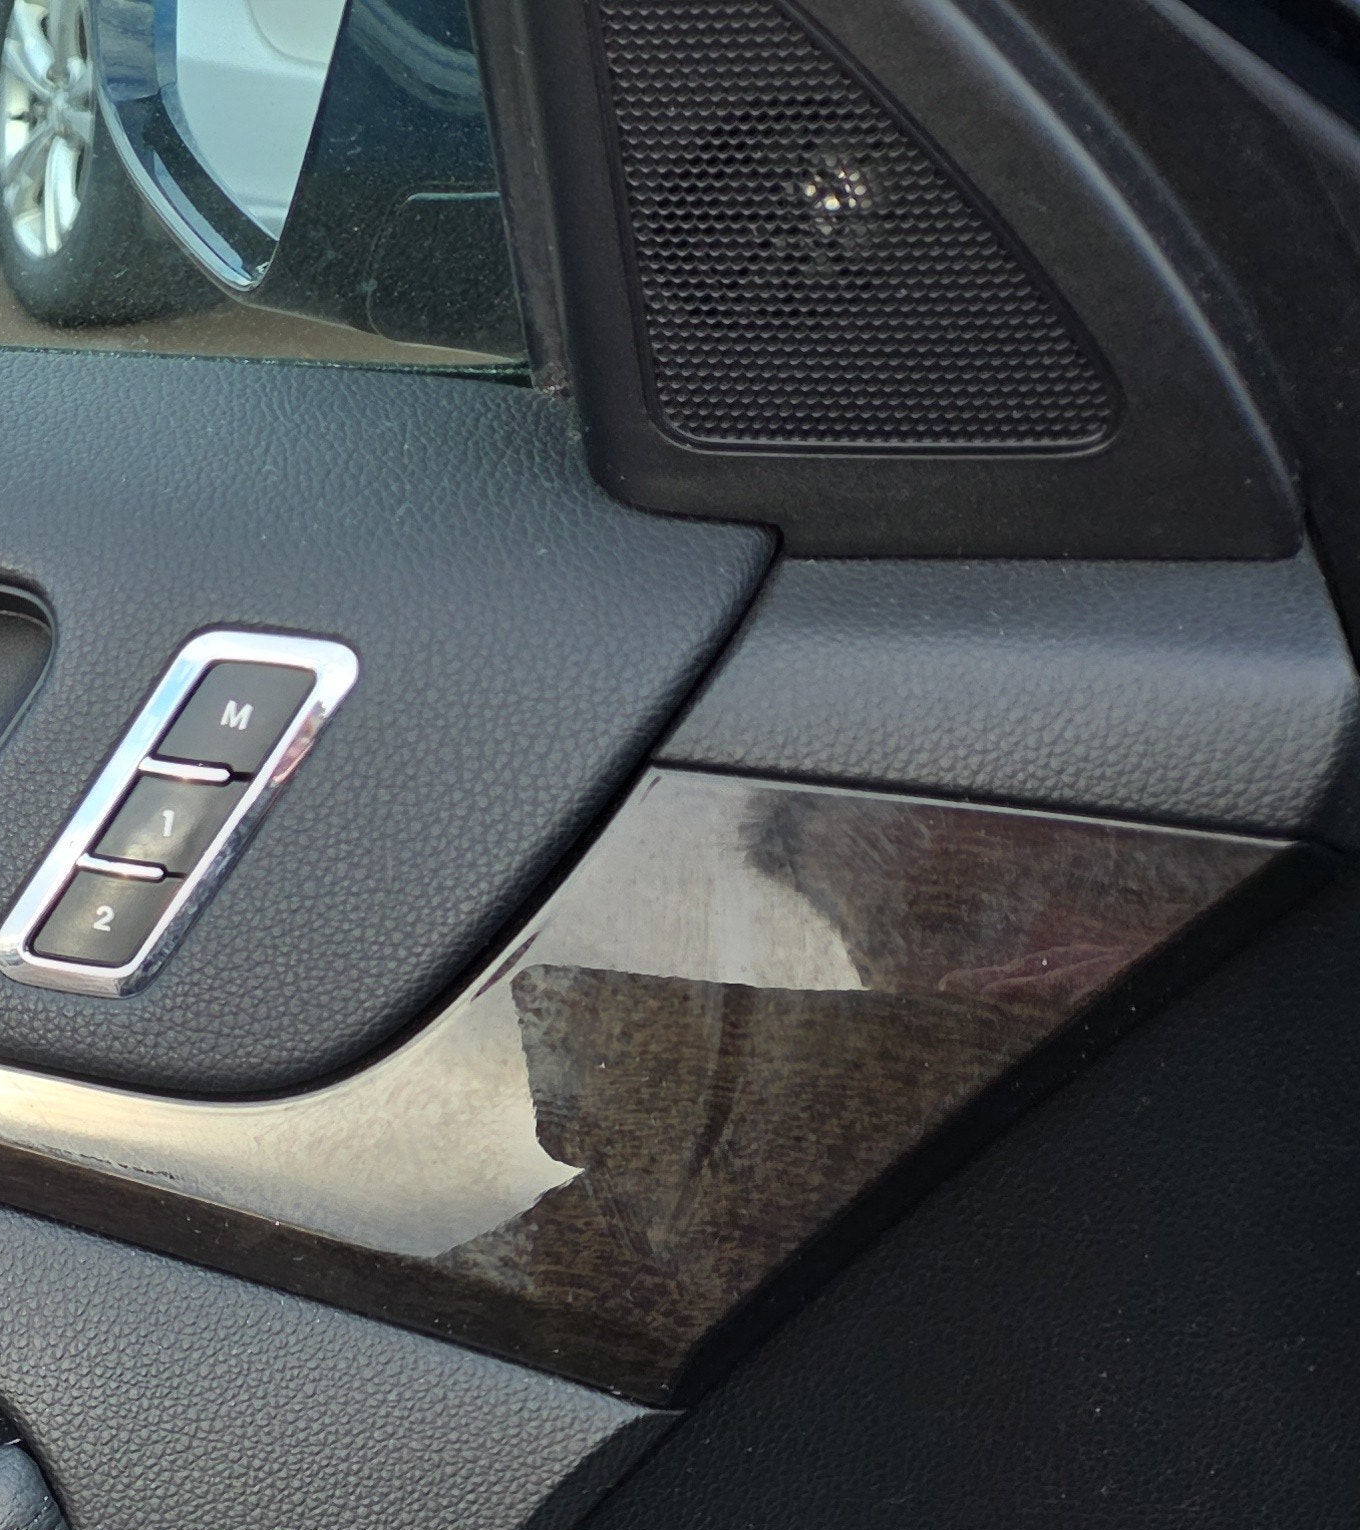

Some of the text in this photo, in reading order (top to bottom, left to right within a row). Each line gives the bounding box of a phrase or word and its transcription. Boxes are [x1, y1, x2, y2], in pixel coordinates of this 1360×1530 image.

[220, 700, 254, 731] M
[161, 810, 175, 837] 1
[93, 905, 115, 932] 2
